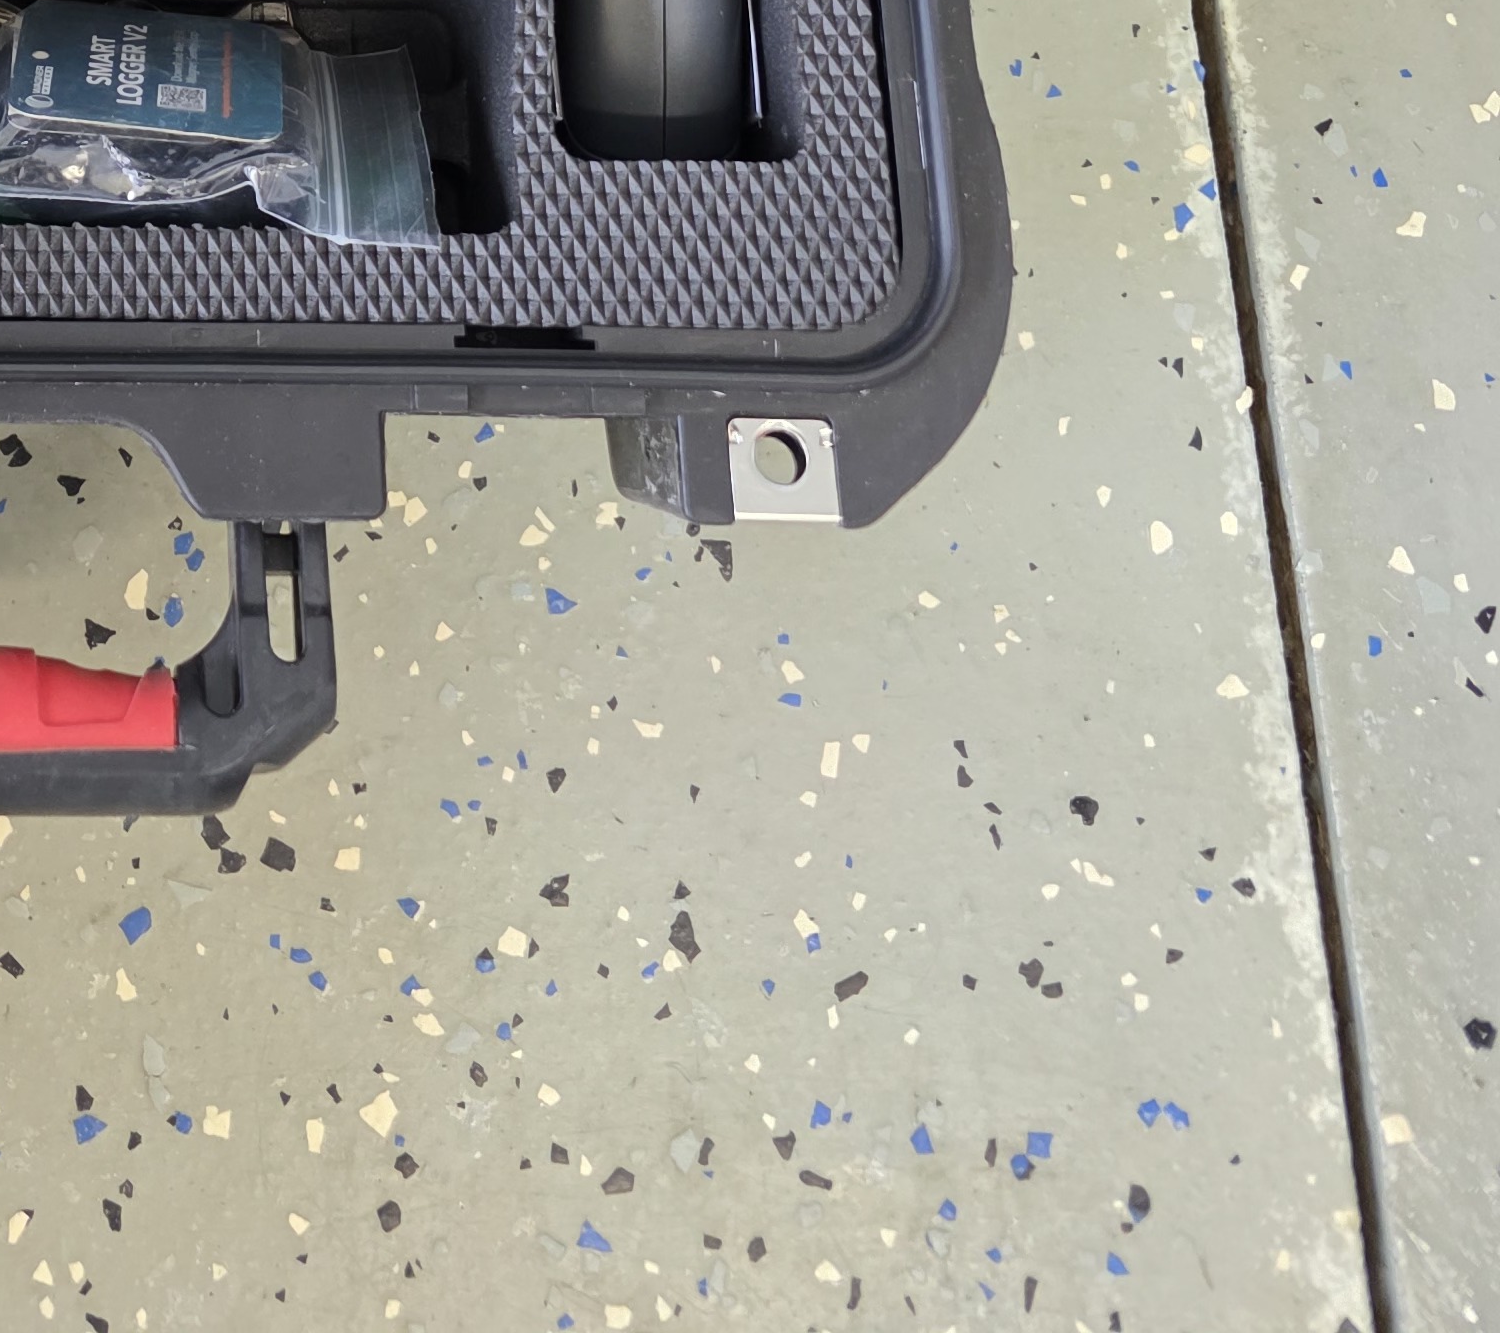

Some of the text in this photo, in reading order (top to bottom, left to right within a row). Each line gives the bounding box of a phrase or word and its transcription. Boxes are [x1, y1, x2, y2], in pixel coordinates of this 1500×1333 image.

[85, 34, 116, 86] SMART
[116, 24, 148, 106] LOGGER V2
